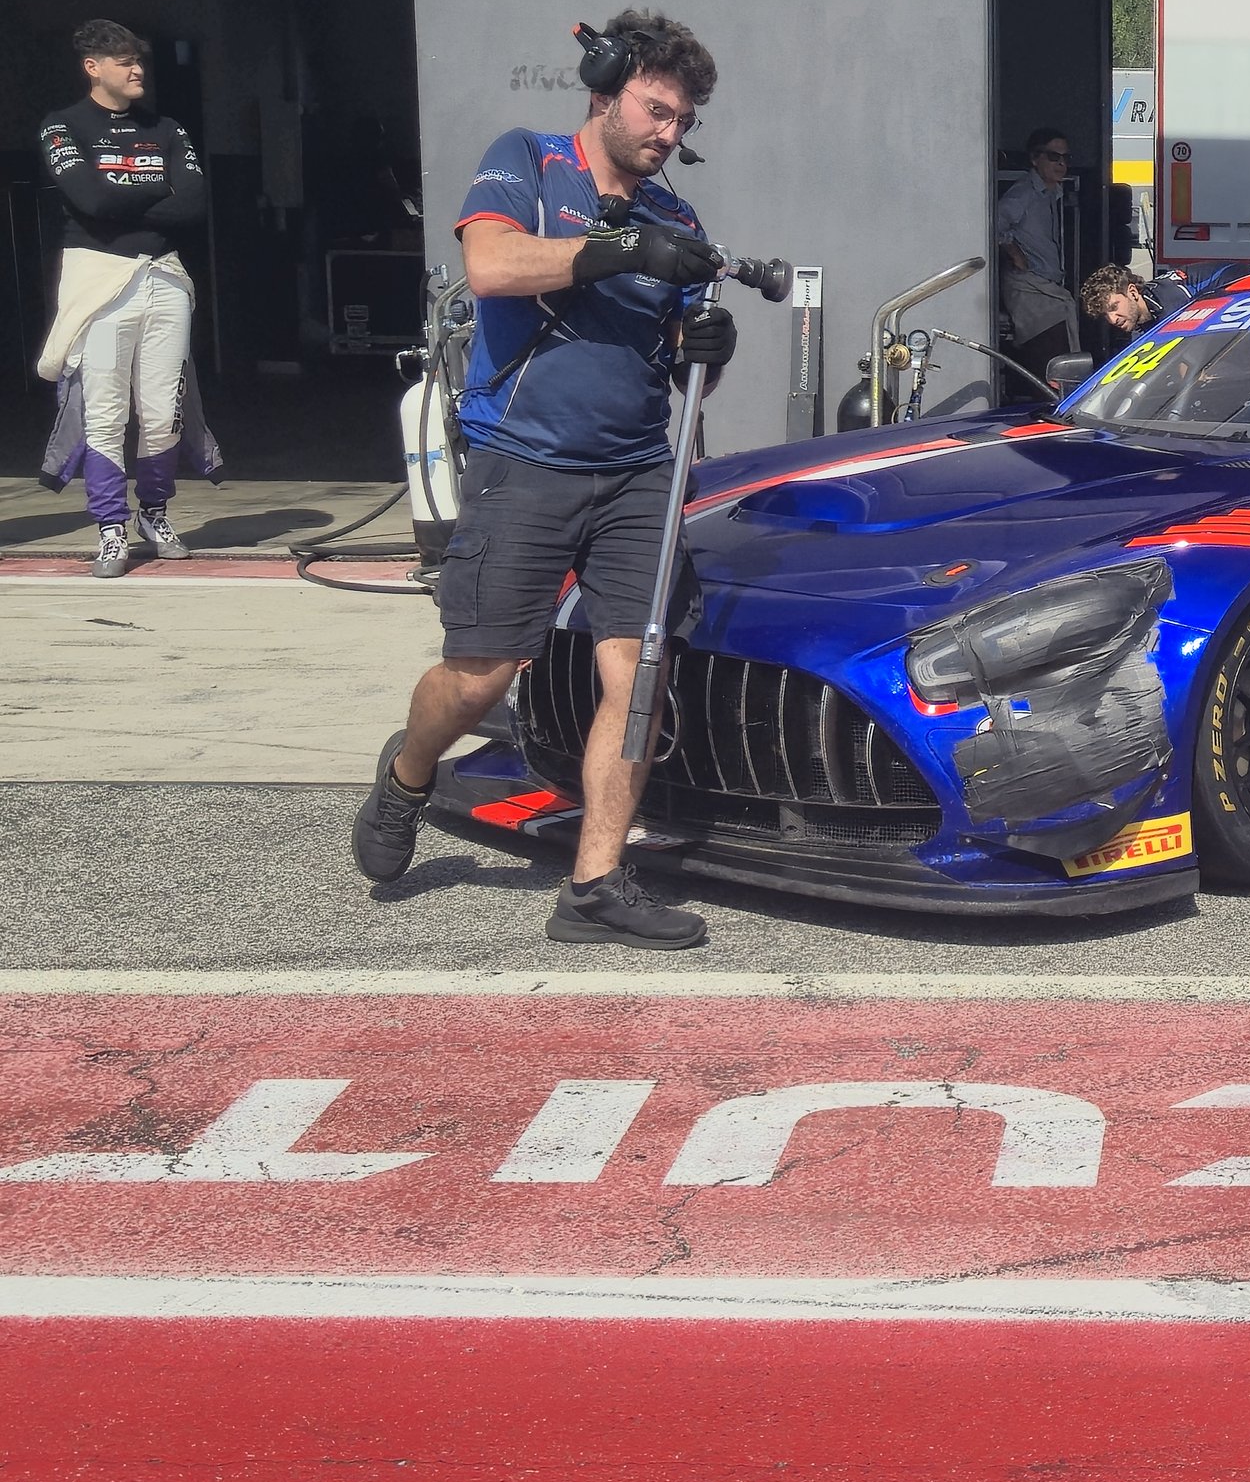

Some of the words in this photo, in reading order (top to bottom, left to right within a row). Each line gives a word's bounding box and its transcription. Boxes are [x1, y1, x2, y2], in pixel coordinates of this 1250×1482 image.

[1176, 146, 1187, 156] 70
[1100, 336, 1184, 385] 64
[1211, 672, 1229, 782] ZERO
[1219, 791, 1237, 812] P
[1073, 824, 1183, 870] PIRELLI
